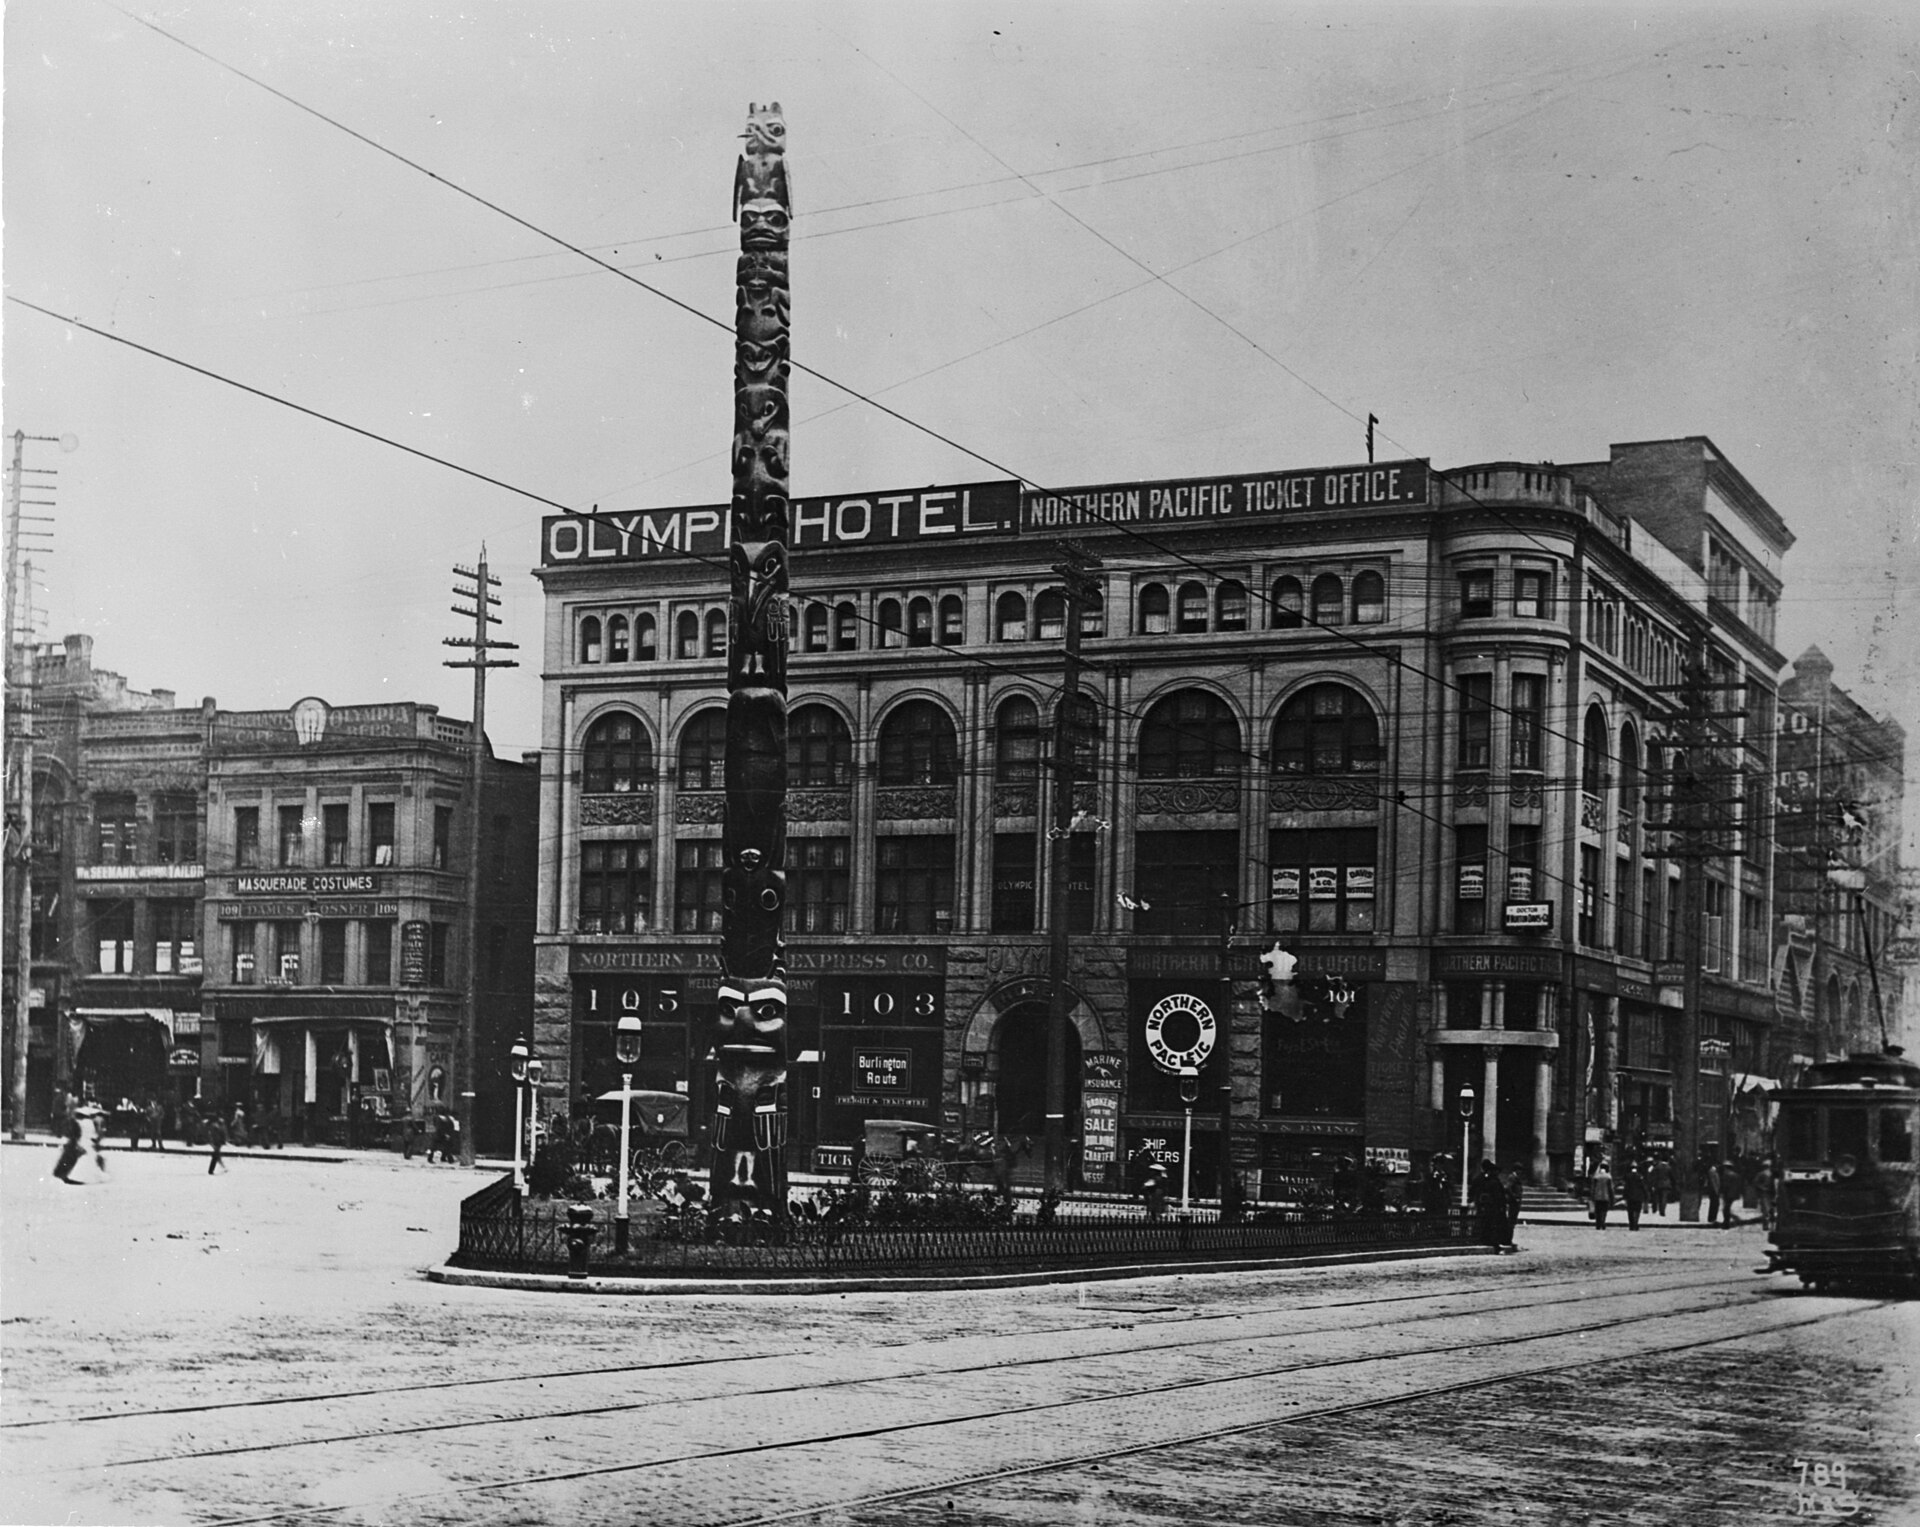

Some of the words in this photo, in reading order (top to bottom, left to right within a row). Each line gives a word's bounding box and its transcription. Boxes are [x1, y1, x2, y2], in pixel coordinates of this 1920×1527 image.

[1030, 490, 1139, 527] NORTHERN
[1149, 483, 1230, 520] PACIFIC
[1242, 477, 1315, 512] TICKET
[550, 508, 731, 560] OLYMPI
[328, 706, 407, 729] OLYMPIA
[238, 877, 308, 892] MASQUERADE
[313, 876, 373, 891] COSTUMES
[998, 880, 1033, 891] OLYMPIC
[220, 905, 238, 916] 109
[379, 904, 398, 915] 109
[579, 953, 683, 968] NORTHERN
[790, 953, 887, 969] EXPRESS
[1493, 955, 1536, 972] PACIFIC
[688, 978, 719, 989] WELLS
[1328, 989, 1355, 1004] 101
[1148, 996, 1214, 1030] NORTHERN
[1150, 1039, 1210, 1066] PACIFIC
[858, 1055, 906, 1072] Burlington
[1085, 1054, 1122, 1069] MARINE
[867, 1071, 897, 1085] Route
[1084, 1079, 1122, 1088] INSURANCE
[1084, 1117, 1115, 1132] SALE
[1142, 1138, 1167, 1150] SHIP
[818, 1153, 852, 1166] TICK
